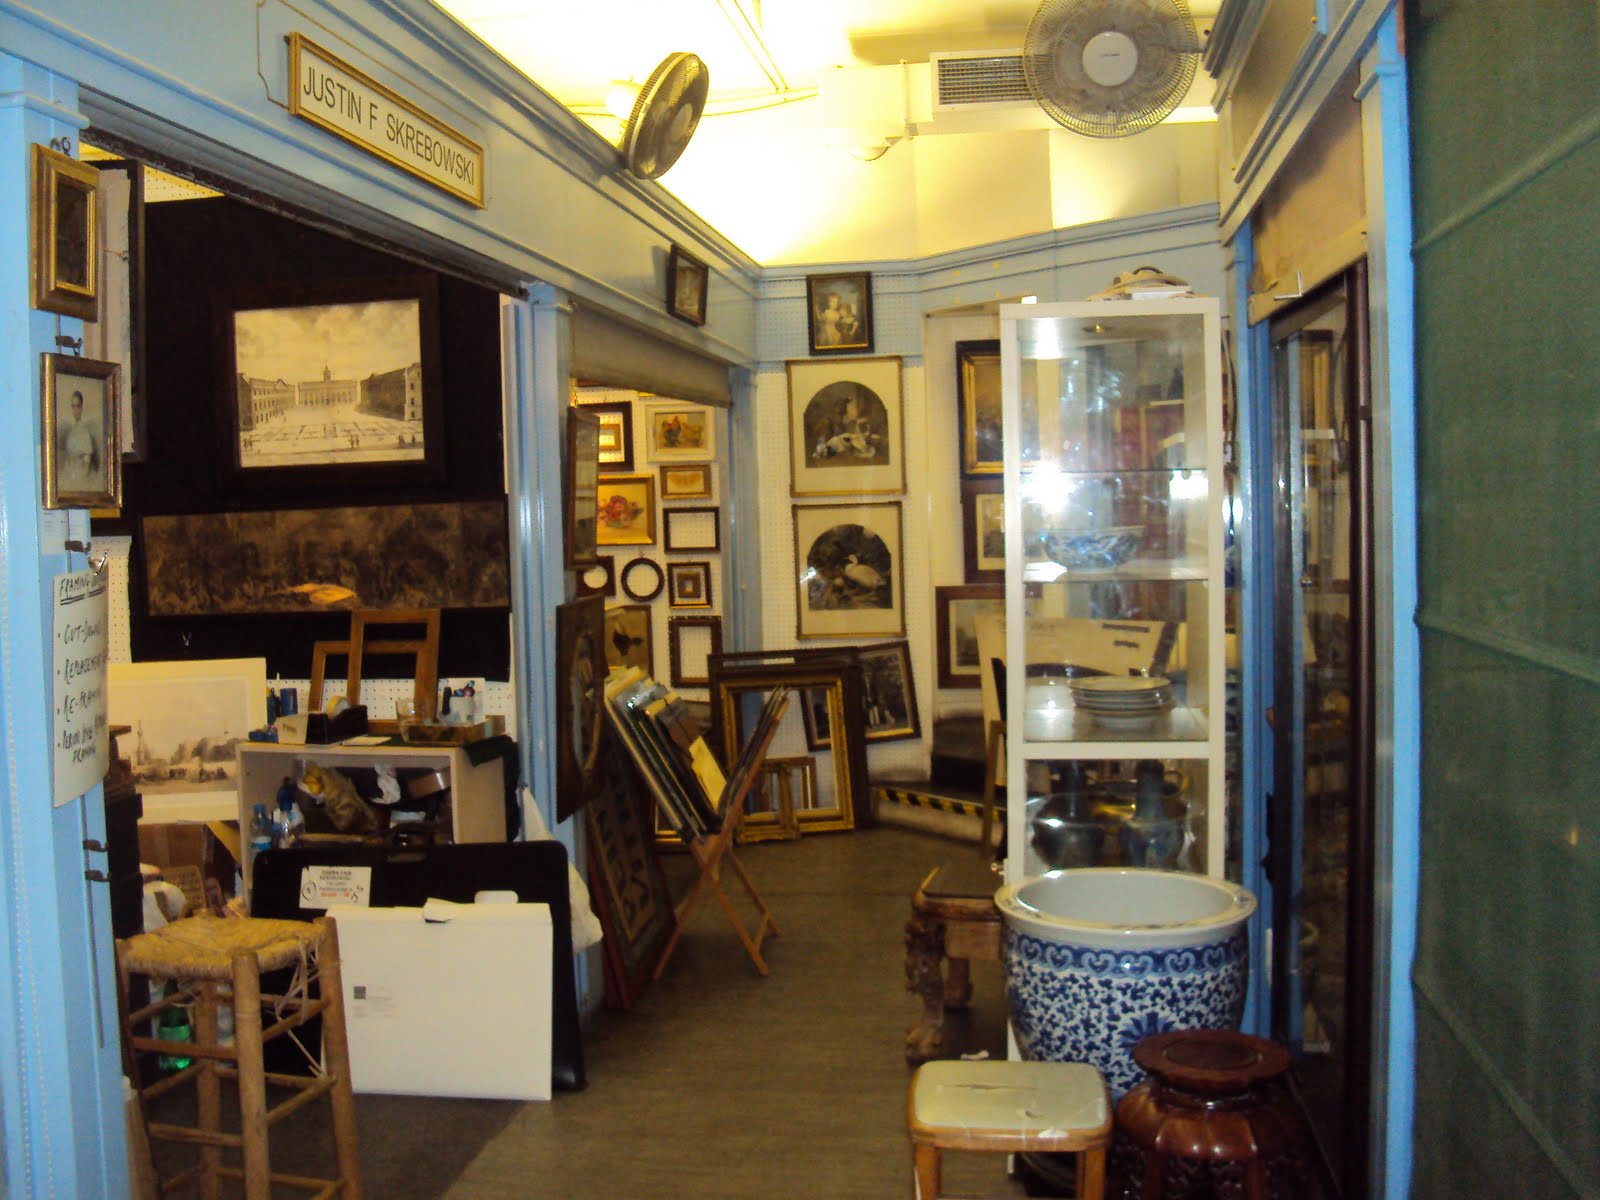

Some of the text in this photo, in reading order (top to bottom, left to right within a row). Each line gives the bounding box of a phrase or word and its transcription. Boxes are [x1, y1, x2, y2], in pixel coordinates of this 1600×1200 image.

[303, 66, 474, 185] JUSTIN F SKREBOWSKI
